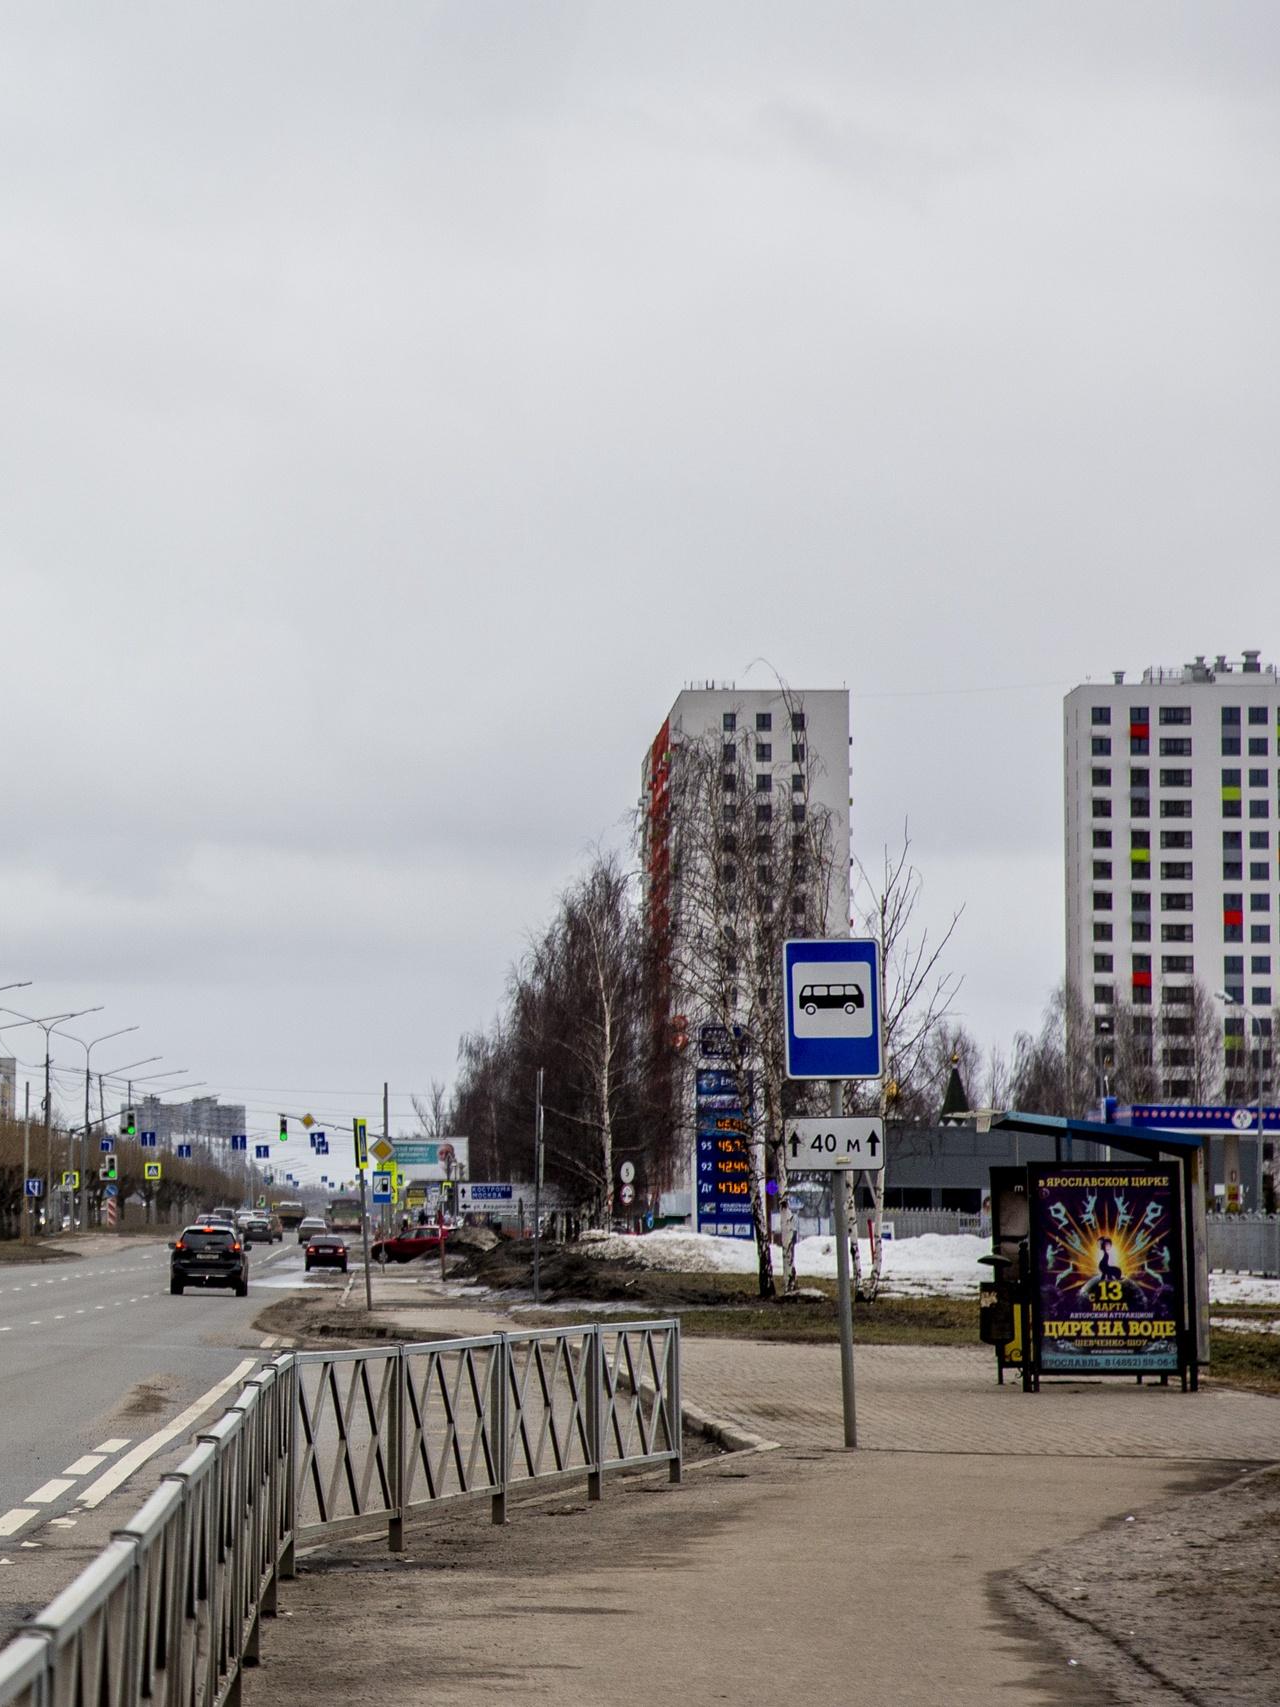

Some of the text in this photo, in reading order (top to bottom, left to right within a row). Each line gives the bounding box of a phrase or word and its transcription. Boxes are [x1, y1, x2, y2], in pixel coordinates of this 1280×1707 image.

[701, 1141, 712, 1151] 95
[810, 1133, 837, 1153] 40
[701, 1161, 713, 1171] 92
[1046, 1176, 1129, 1187] ЯРОСЛАВСКОМ
[1131, 1176, 1170, 1187] ЦИРКЕ
[1098, 1280, 1123, 1301] 13
[1092, 1302, 1129, 1312] МАРТА
[1069, 1311, 1154, 1319] АВТОРСКИЙ АТТРАКЦИОН
[1043, 1320, 1177, 1339] ЦИРК НА ВОДЕ
